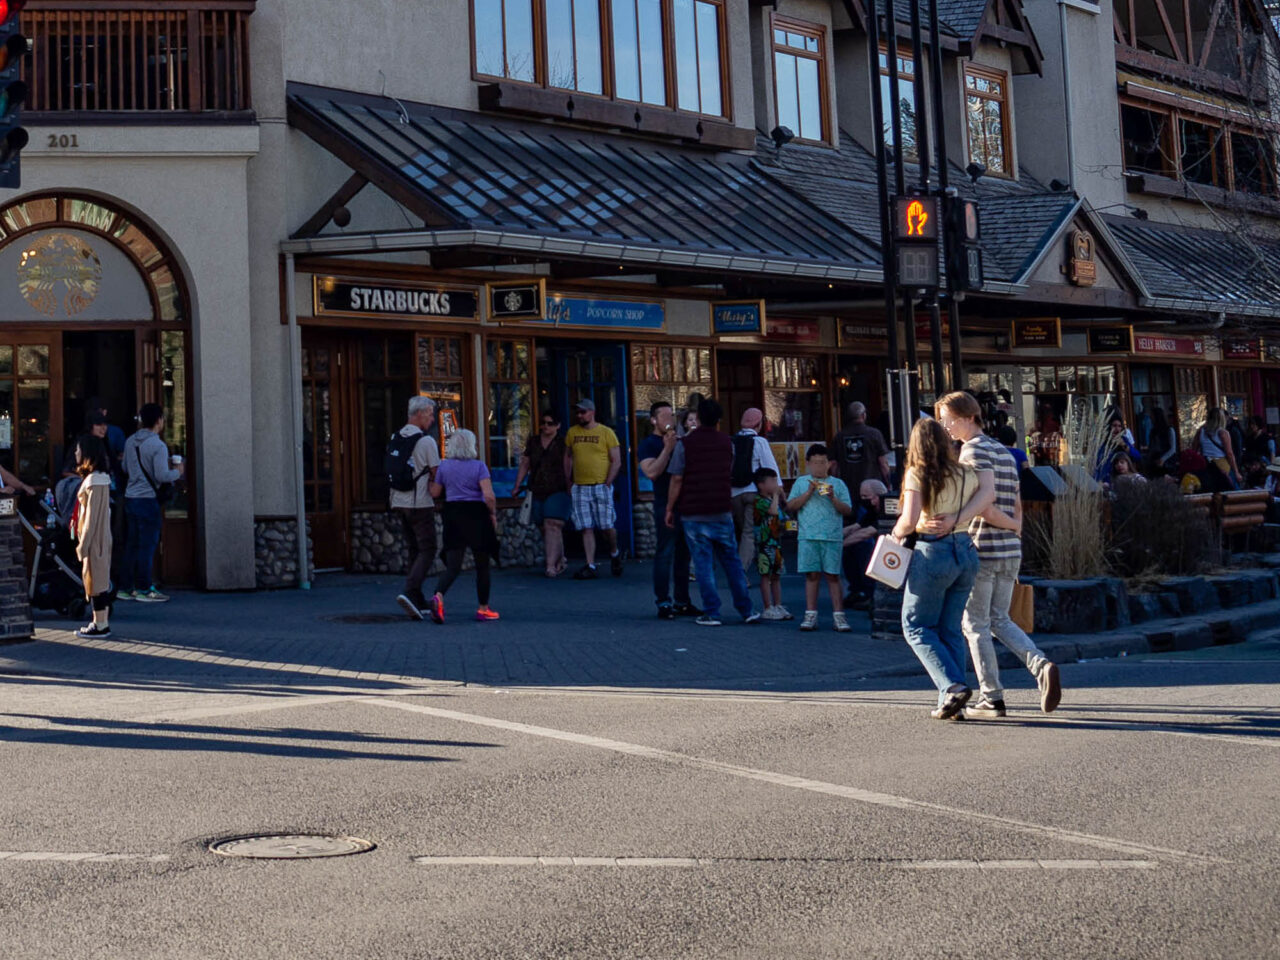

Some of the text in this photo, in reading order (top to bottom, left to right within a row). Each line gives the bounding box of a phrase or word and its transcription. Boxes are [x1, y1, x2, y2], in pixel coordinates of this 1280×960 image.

[48, 134, 79, 148] 201
[350, 287, 451, 315] STARBUCKS
[586, 306, 623, 320] POPCORN
[624, 309, 644, 320] SHOP
[1137, 337, 1153, 351] HELLY
